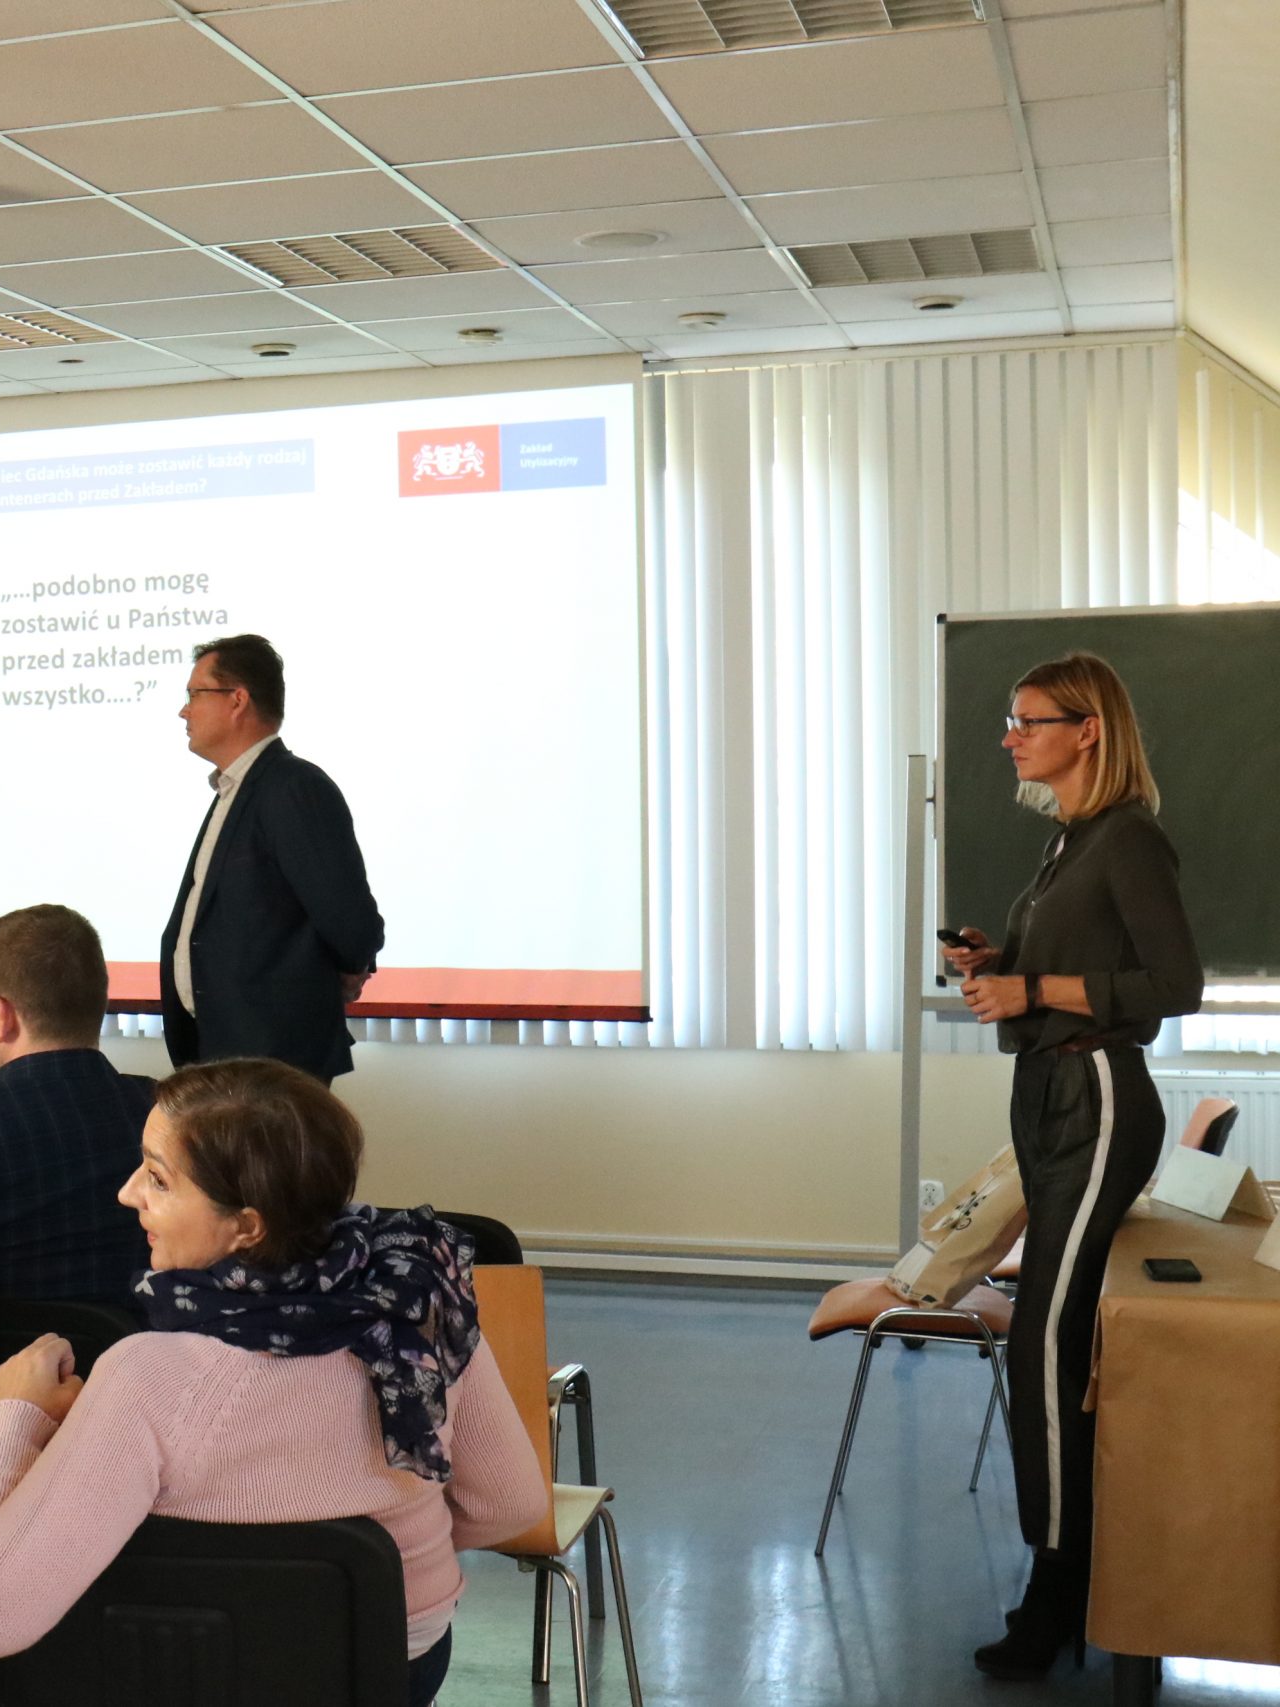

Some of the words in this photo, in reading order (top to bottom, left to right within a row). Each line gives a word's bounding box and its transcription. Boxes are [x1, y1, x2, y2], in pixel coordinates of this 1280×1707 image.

[25, 462, 89, 483] Gdańska
[93, 459, 134, 478] może
[138, 453, 204, 474] zostawić
[207, 451, 253, 471] każdy
[256, 447, 307, 467] rodzaj
[78, 484, 120, 505] przed
[123, 478, 207, 499] Zakładem?
[145, 571, 209, 595] mogę
[1, 608, 99, 635] zostawić
[107, 615, 120, 631] u
[128, 605, 229, 629] Państwa
[2, 648, 65, 676] przed
[72, 640, 183, 670] zakładem
